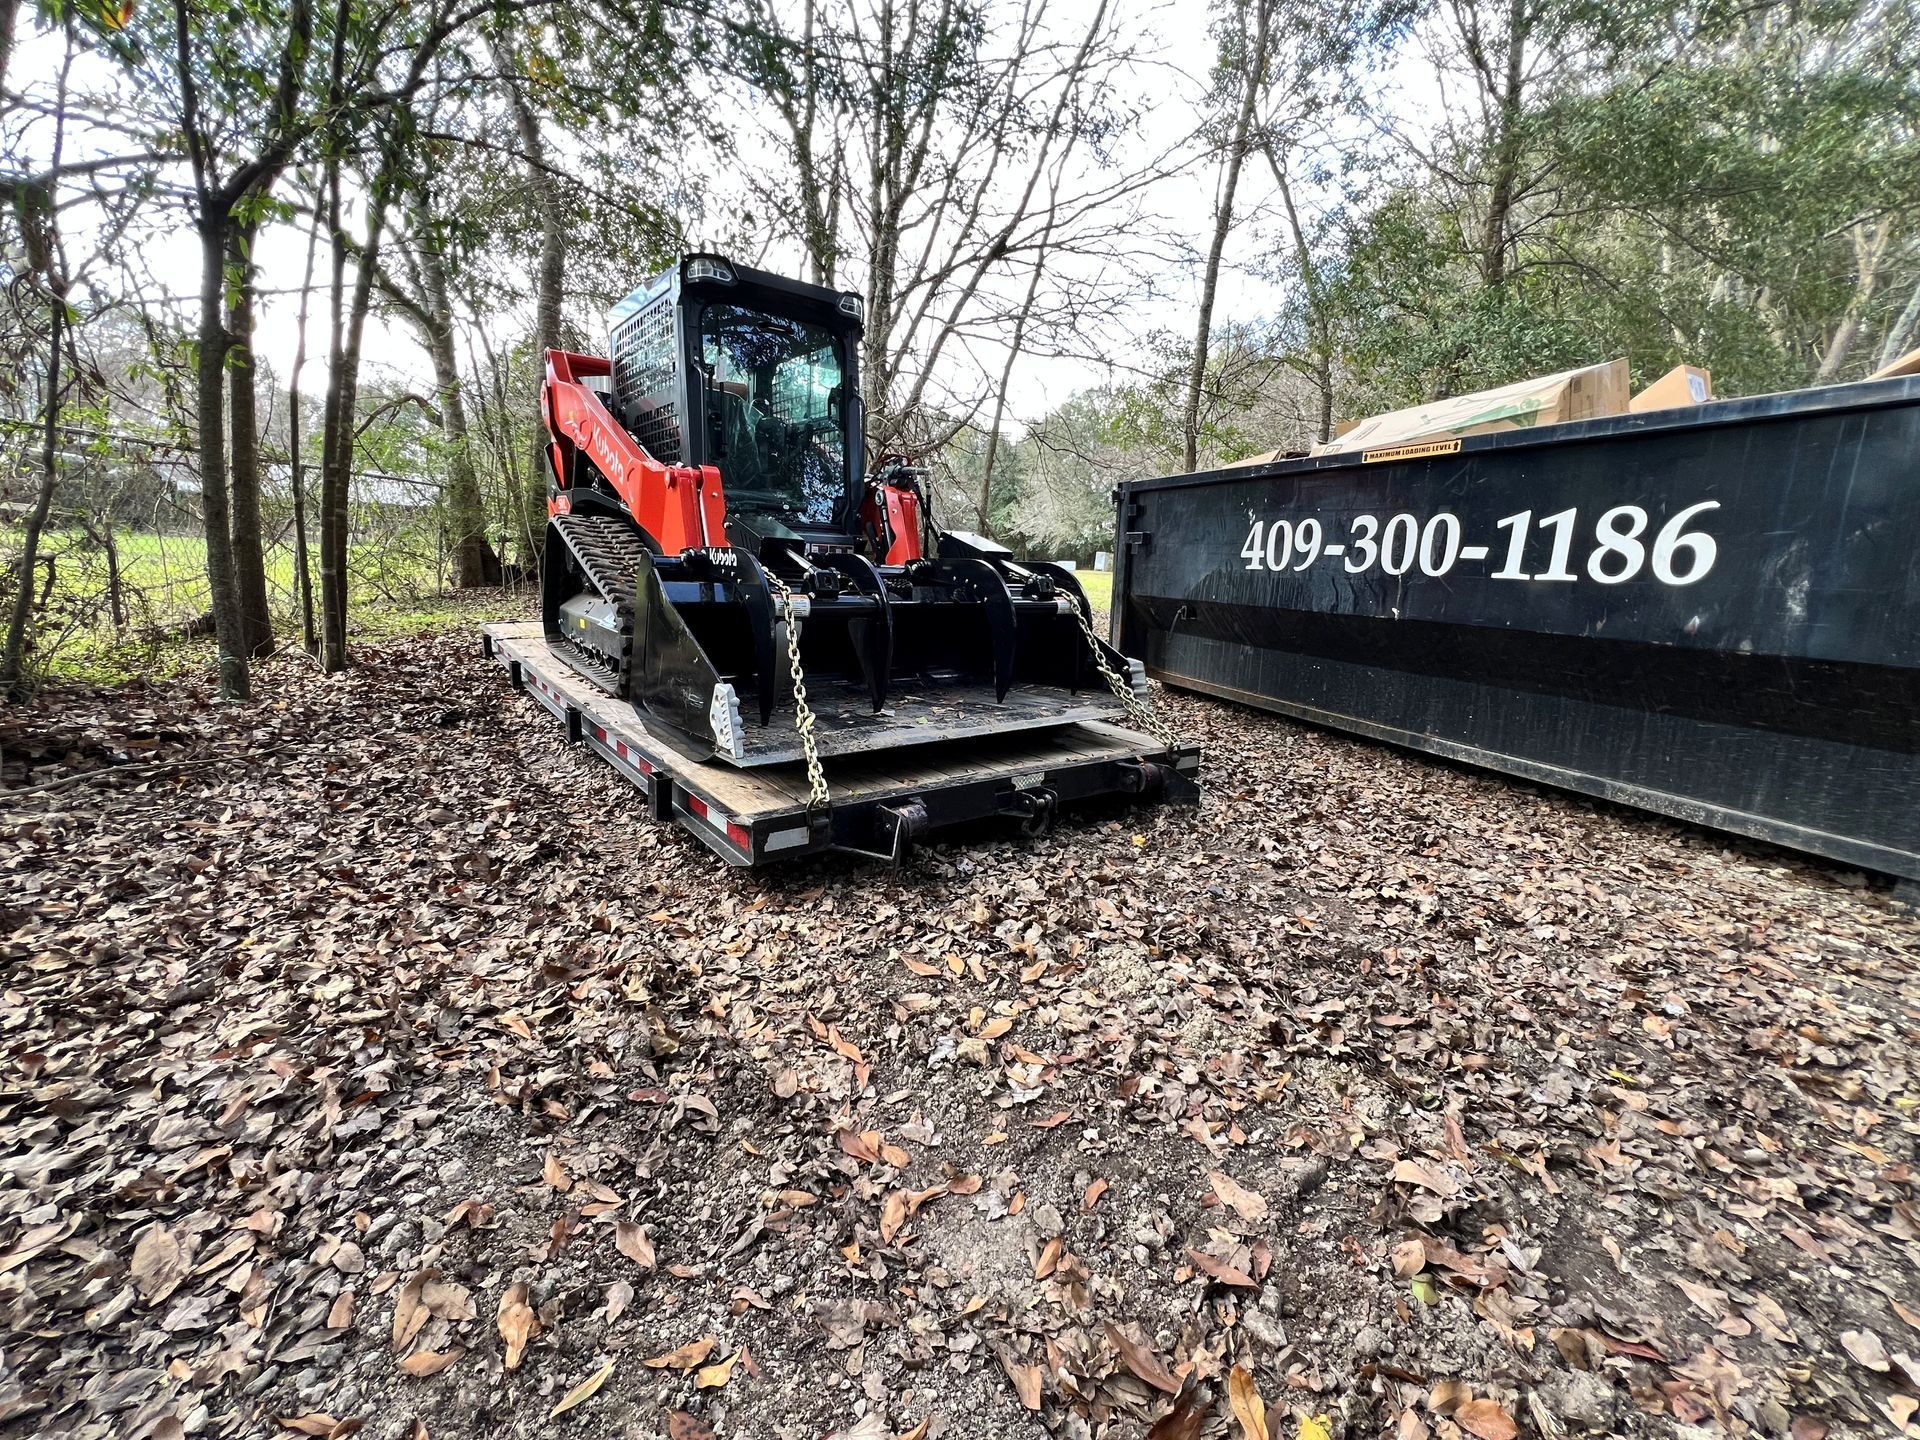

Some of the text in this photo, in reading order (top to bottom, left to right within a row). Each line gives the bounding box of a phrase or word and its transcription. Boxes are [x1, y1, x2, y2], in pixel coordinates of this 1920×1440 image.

[593, 422, 624, 485] Kubota
[1369, 444, 1452, 459] MAXIMUM LOADING LEVEL
[709, 548, 737, 566] Kubota
[1241, 501, 1722, 585] 409-300-1186
